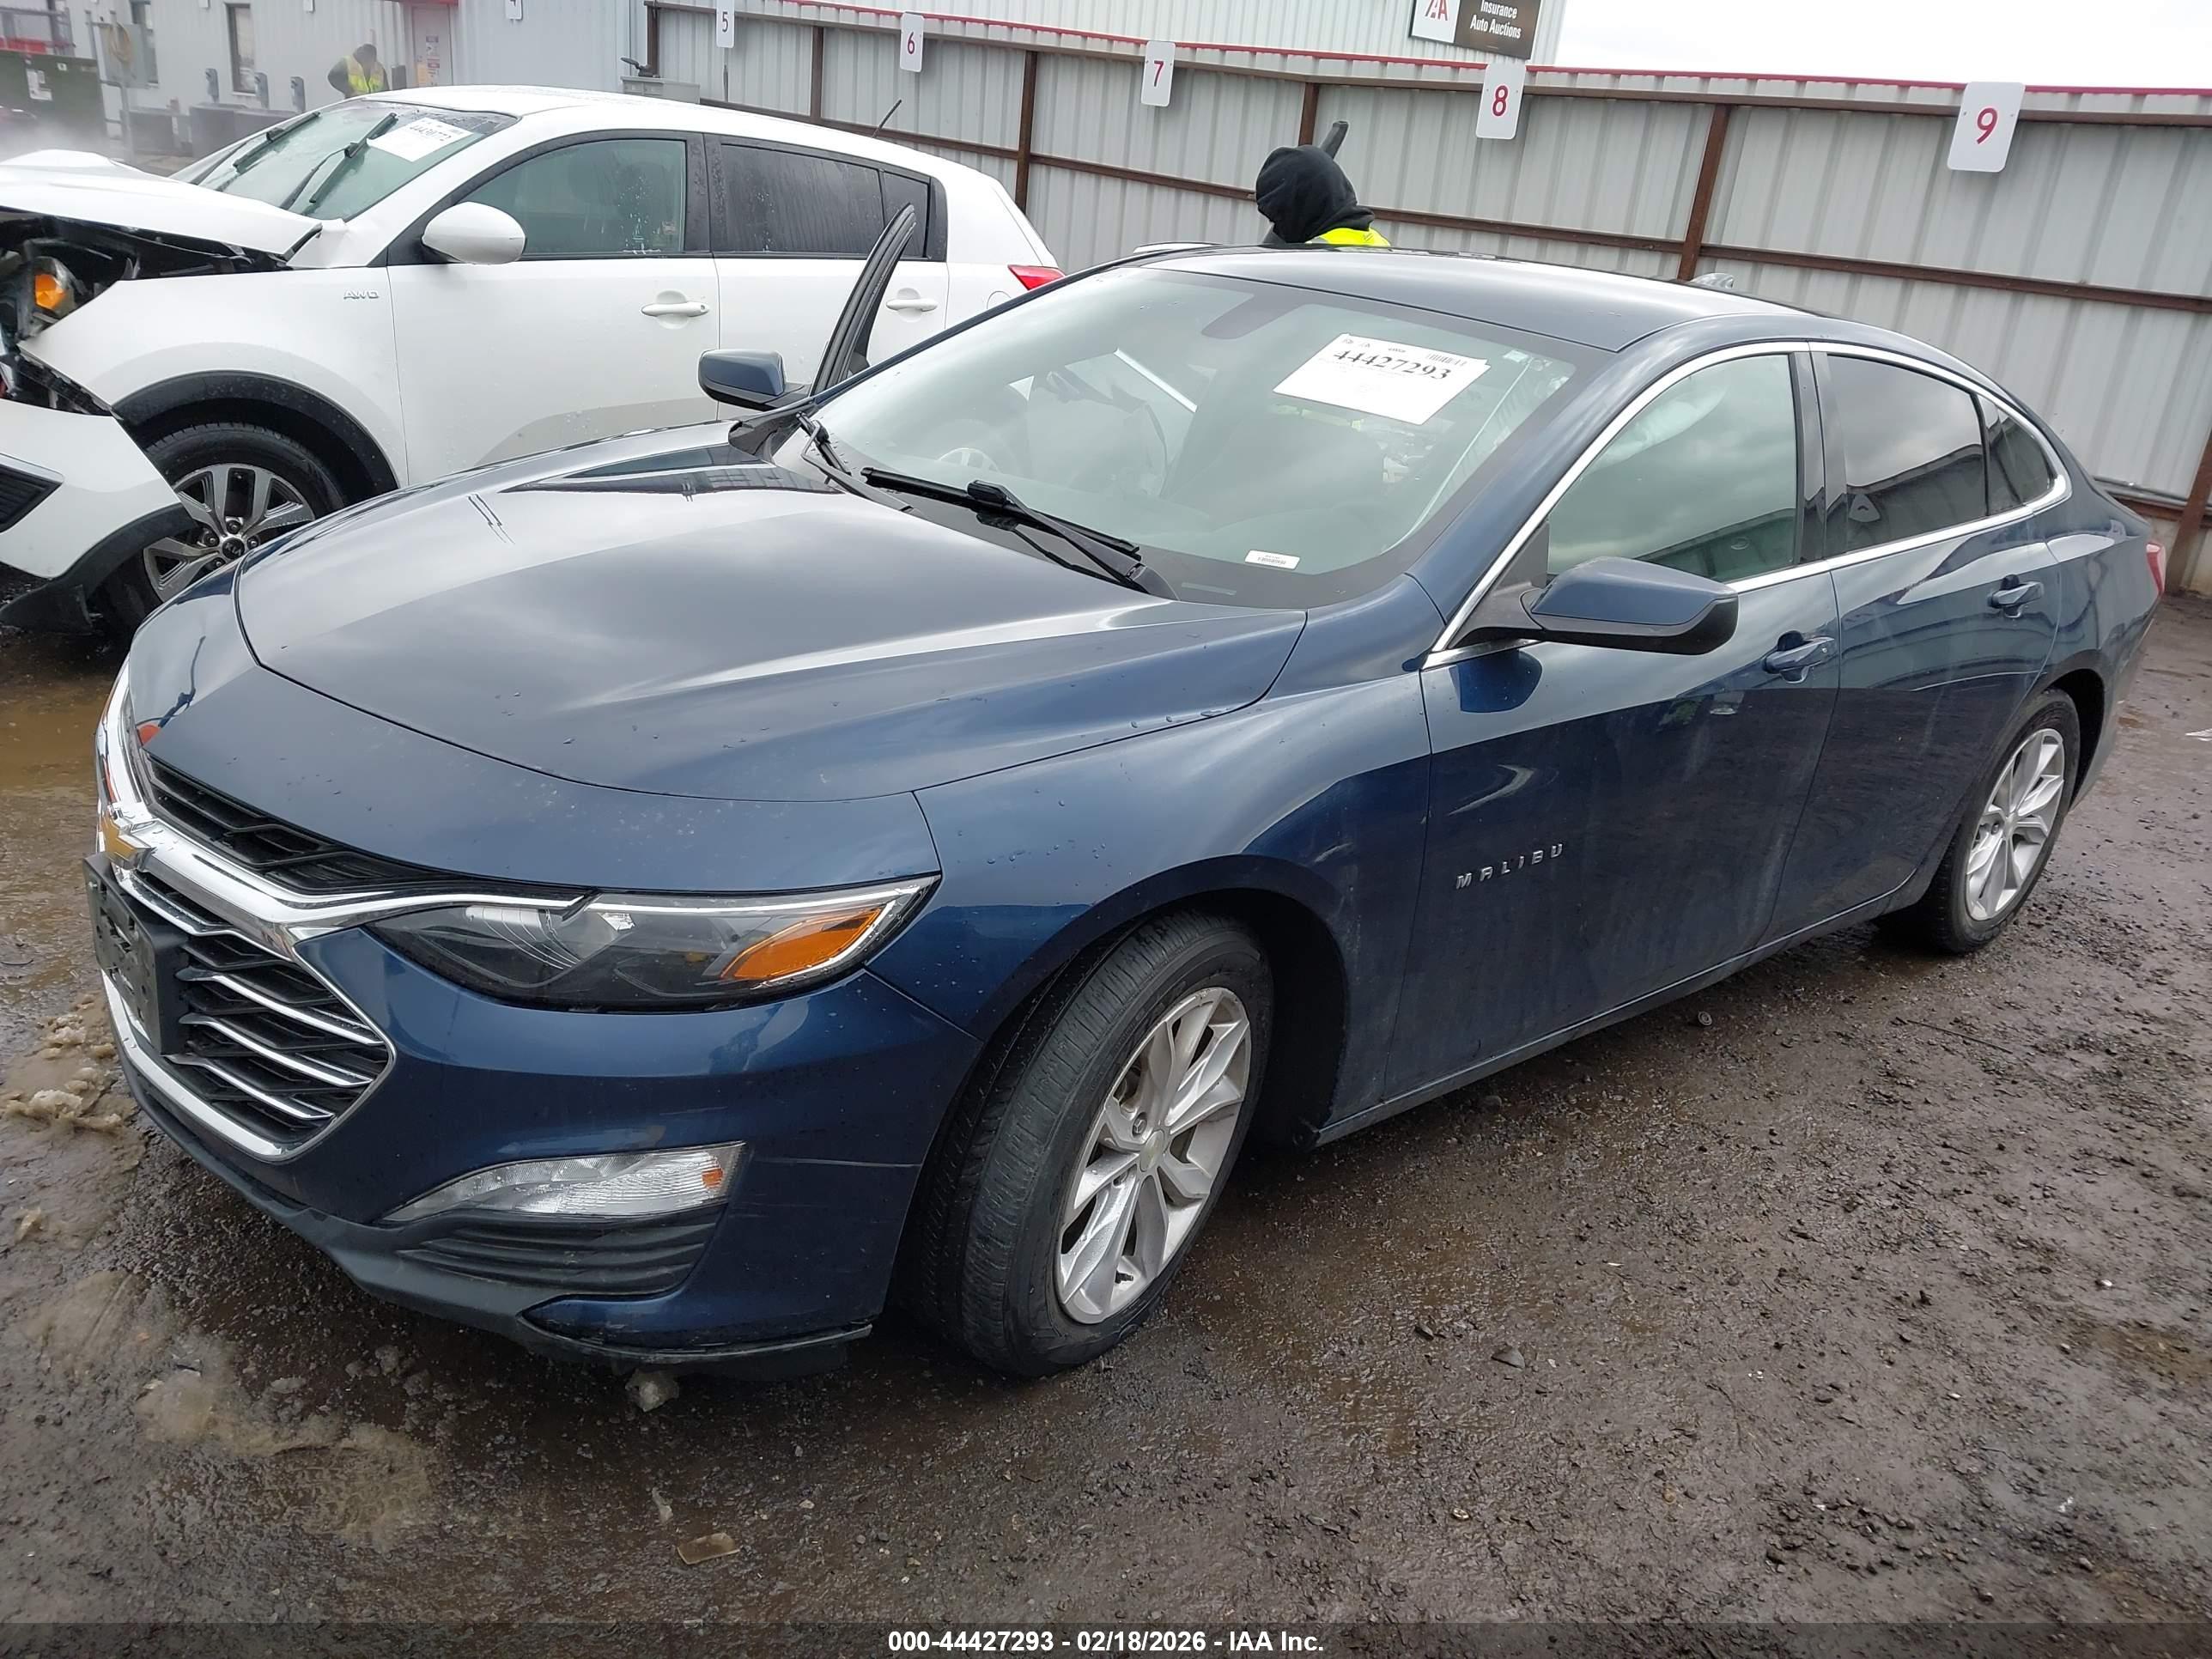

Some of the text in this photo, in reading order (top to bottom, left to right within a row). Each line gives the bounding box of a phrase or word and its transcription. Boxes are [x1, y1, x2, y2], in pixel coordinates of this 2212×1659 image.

[721, 10, 729, 33] 5
[1480, 0, 1518, 19] Insurance
[1469, 14, 1522, 40] Auto Auctions
[907, 31, 915, 55] 6
[1153, 60, 1164, 88] 7
[1492, 84, 1509, 117] 8
[1976, 107, 1998, 145] 9
[343, 289, 380, 300] AWD
[1333, 349, 1452, 380] 44427293
[1455, 843, 1564, 890] MALIBU
